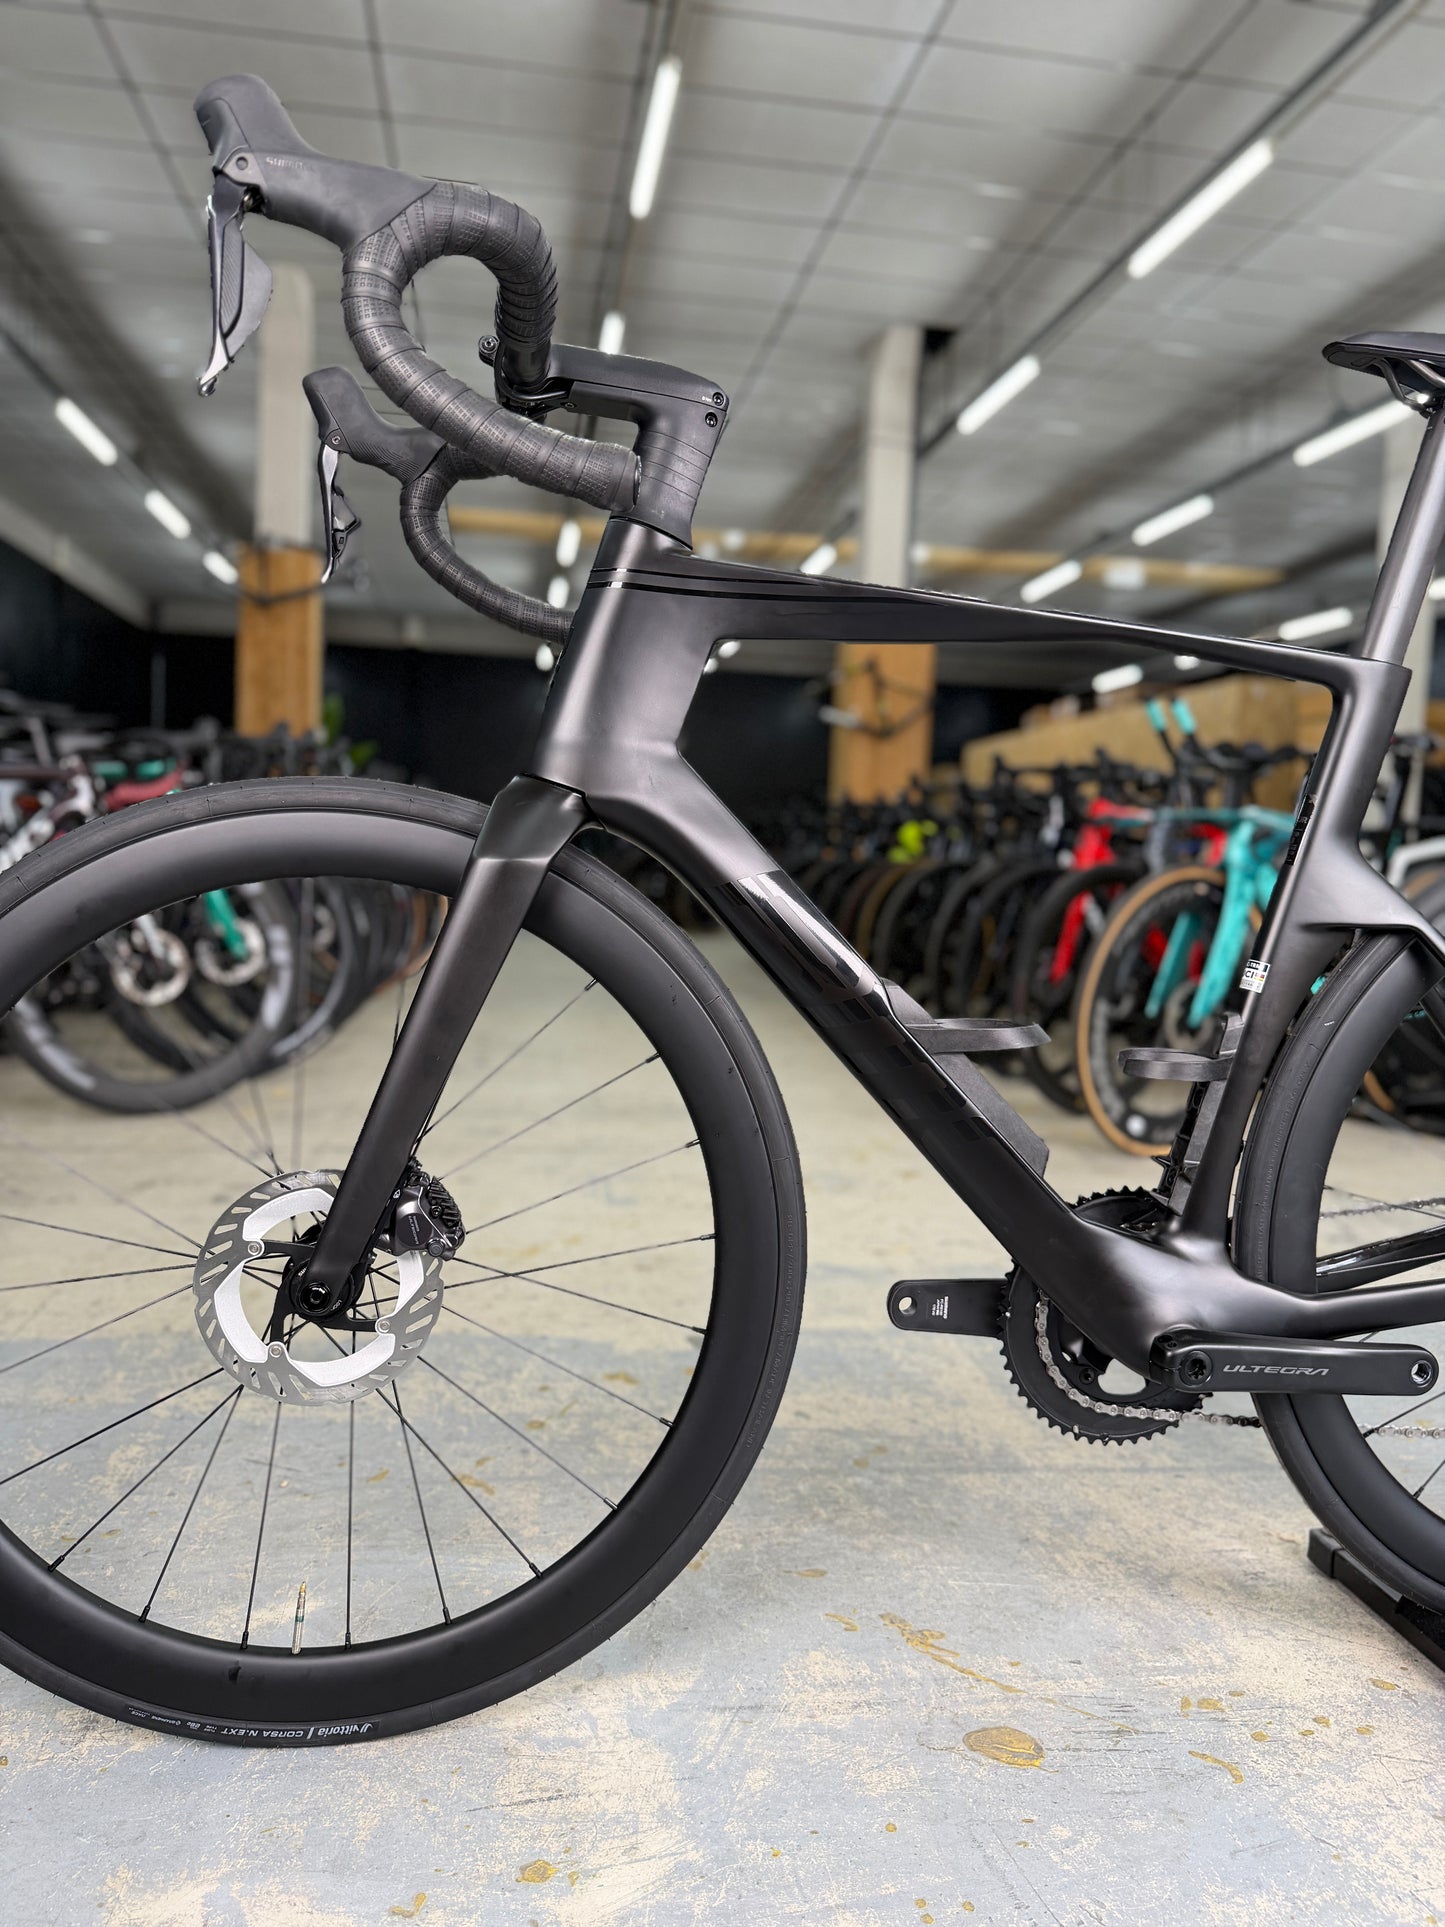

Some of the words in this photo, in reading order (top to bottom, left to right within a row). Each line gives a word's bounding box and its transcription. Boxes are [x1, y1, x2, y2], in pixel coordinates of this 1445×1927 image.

[1222, 1364, 1330, 1376] ULTEGRA
[221, 1727, 259, 1737] N.EXT
[262, 1730, 304, 1738] CORSA
[317, 1723, 360, 1738] vittoria
